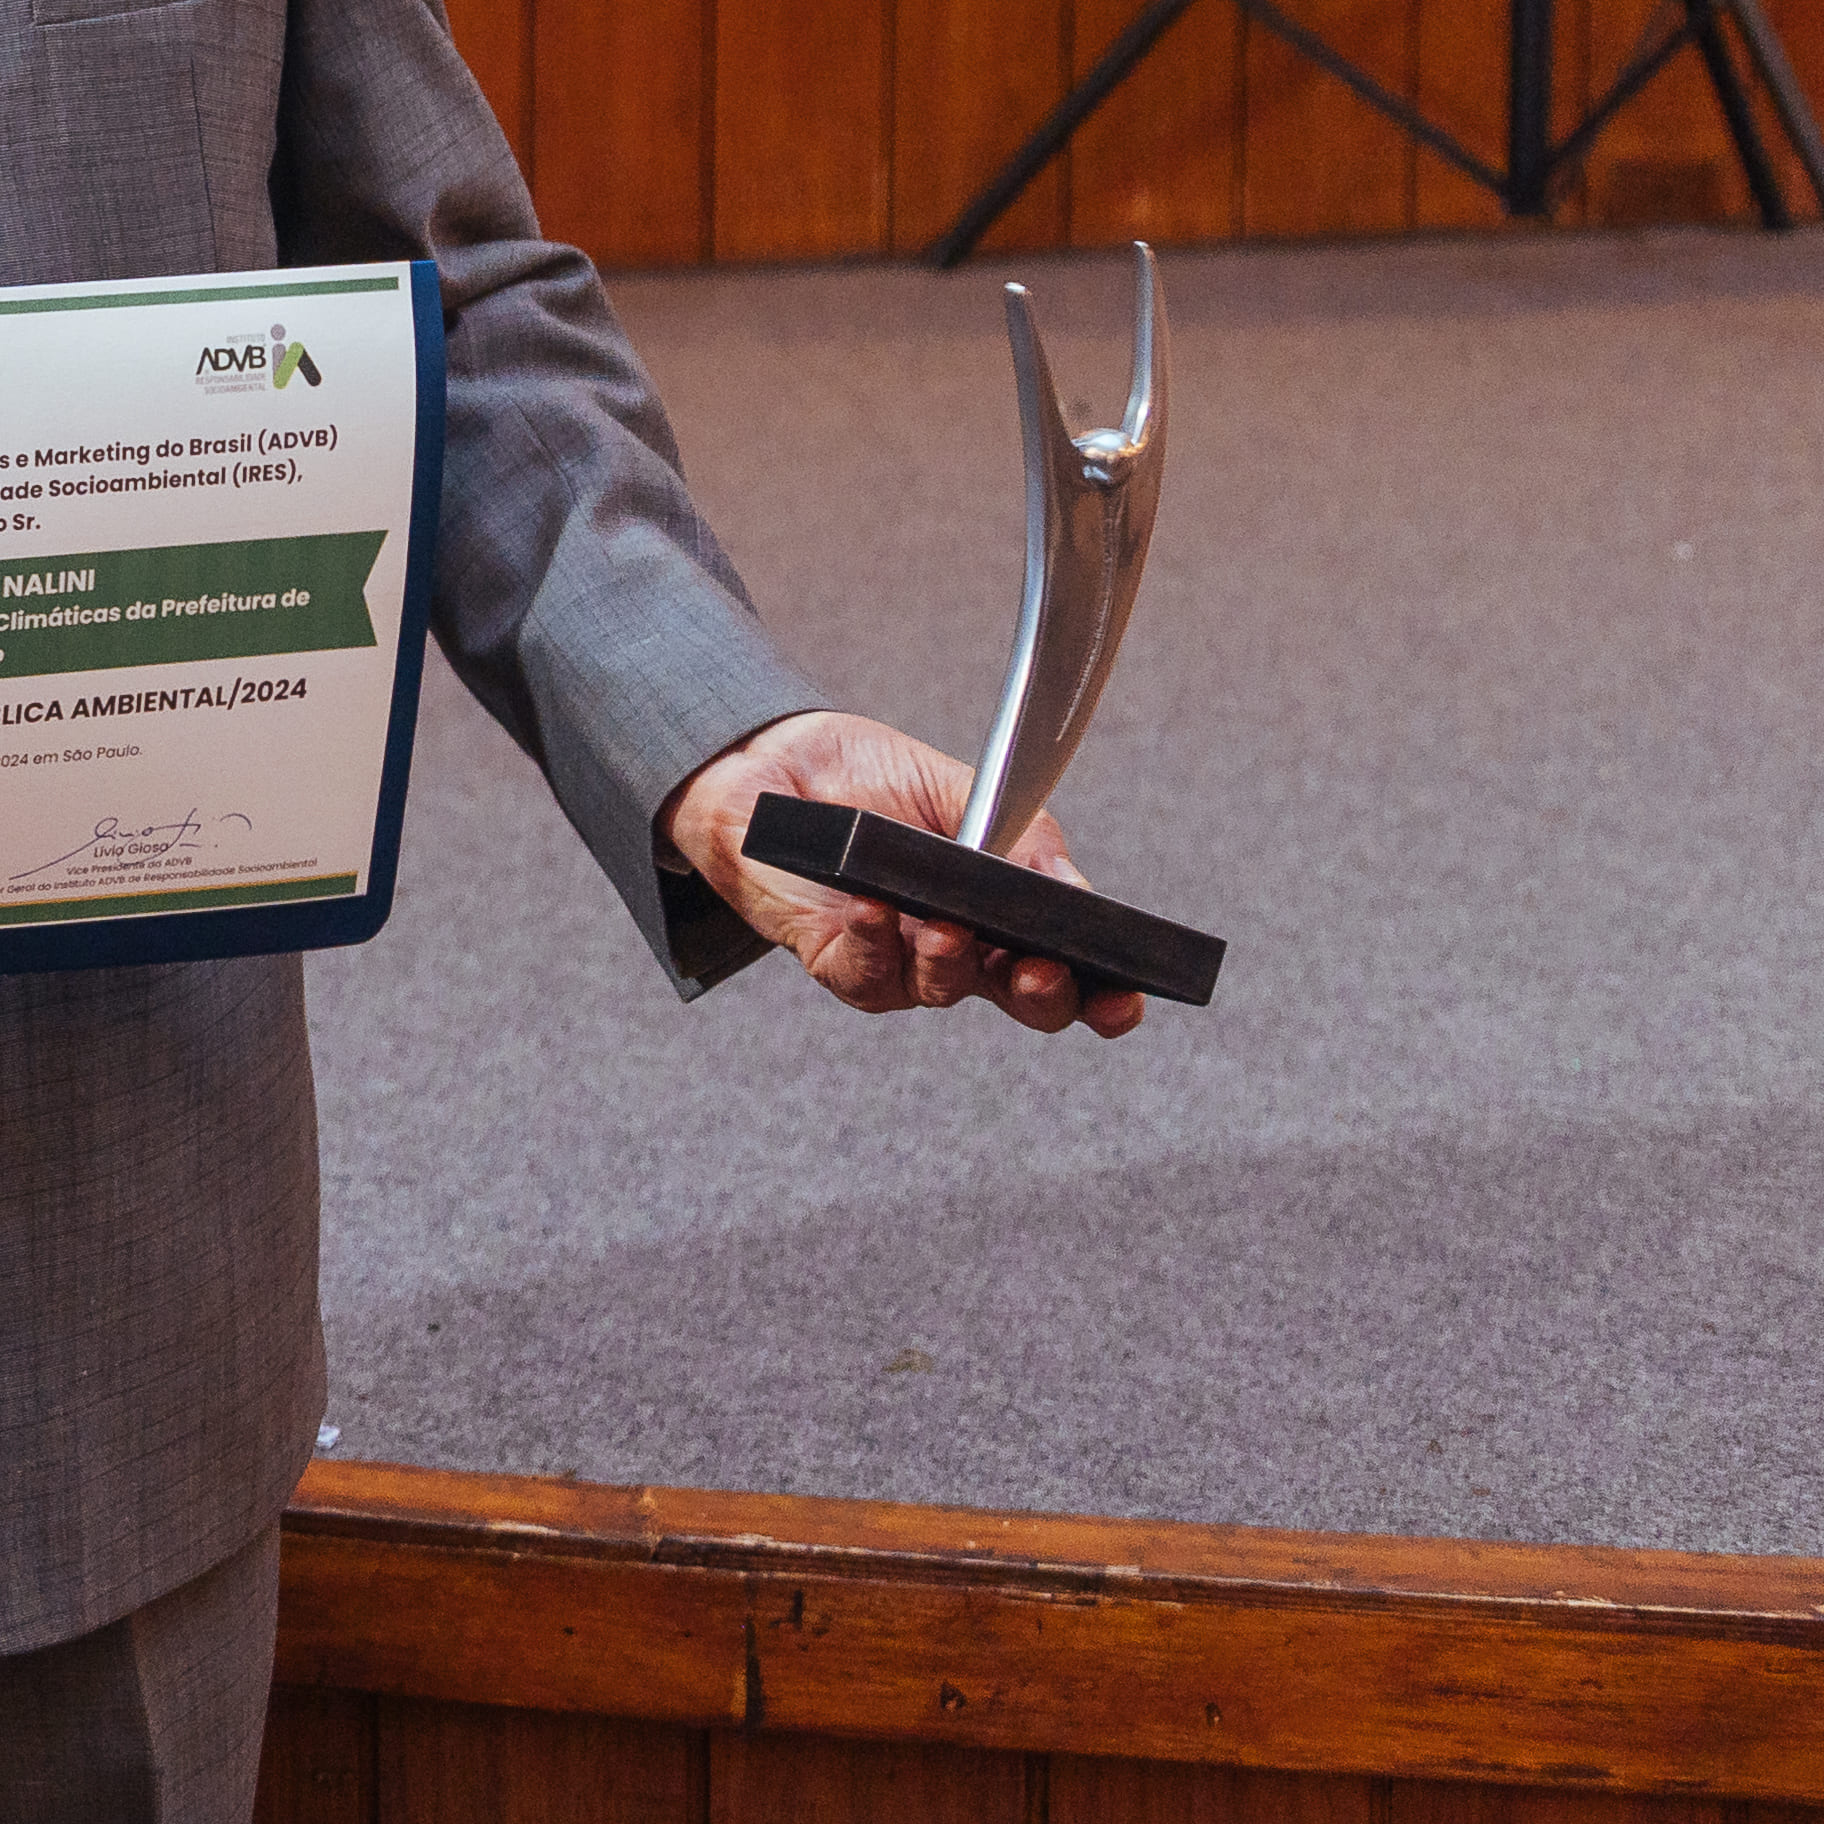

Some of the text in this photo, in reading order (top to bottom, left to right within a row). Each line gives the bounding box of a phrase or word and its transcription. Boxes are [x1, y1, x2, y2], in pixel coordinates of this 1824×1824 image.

[196, 344, 267, 376] ADVB
[16, 454, 28, 468] e
[35, 442, 150, 467] Marketing
[156, 440, 183, 458] do
[190, 433, 251, 456] Brasil
[258, 424, 337, 457] (ADVB)
[49, 467, 226, 497] Socioambiental
[233, 458, 302, 488] (IRES),
[13, 511, 40, 530] Sr.
[3, 569, 95, 598] NALINI
[126, 601, 156, 620] da
[162, 592, 276, 617] Prefeitura
[281, 588, 310, 607] de
[71, 677, 307, 719] AMBIENTAL/2024
[33, 753, 59, 764] em
[63, 749, 92, 762] São
[97, 745, 142, 758] Paulo.
[128, 841, 169, 854] Giosa
